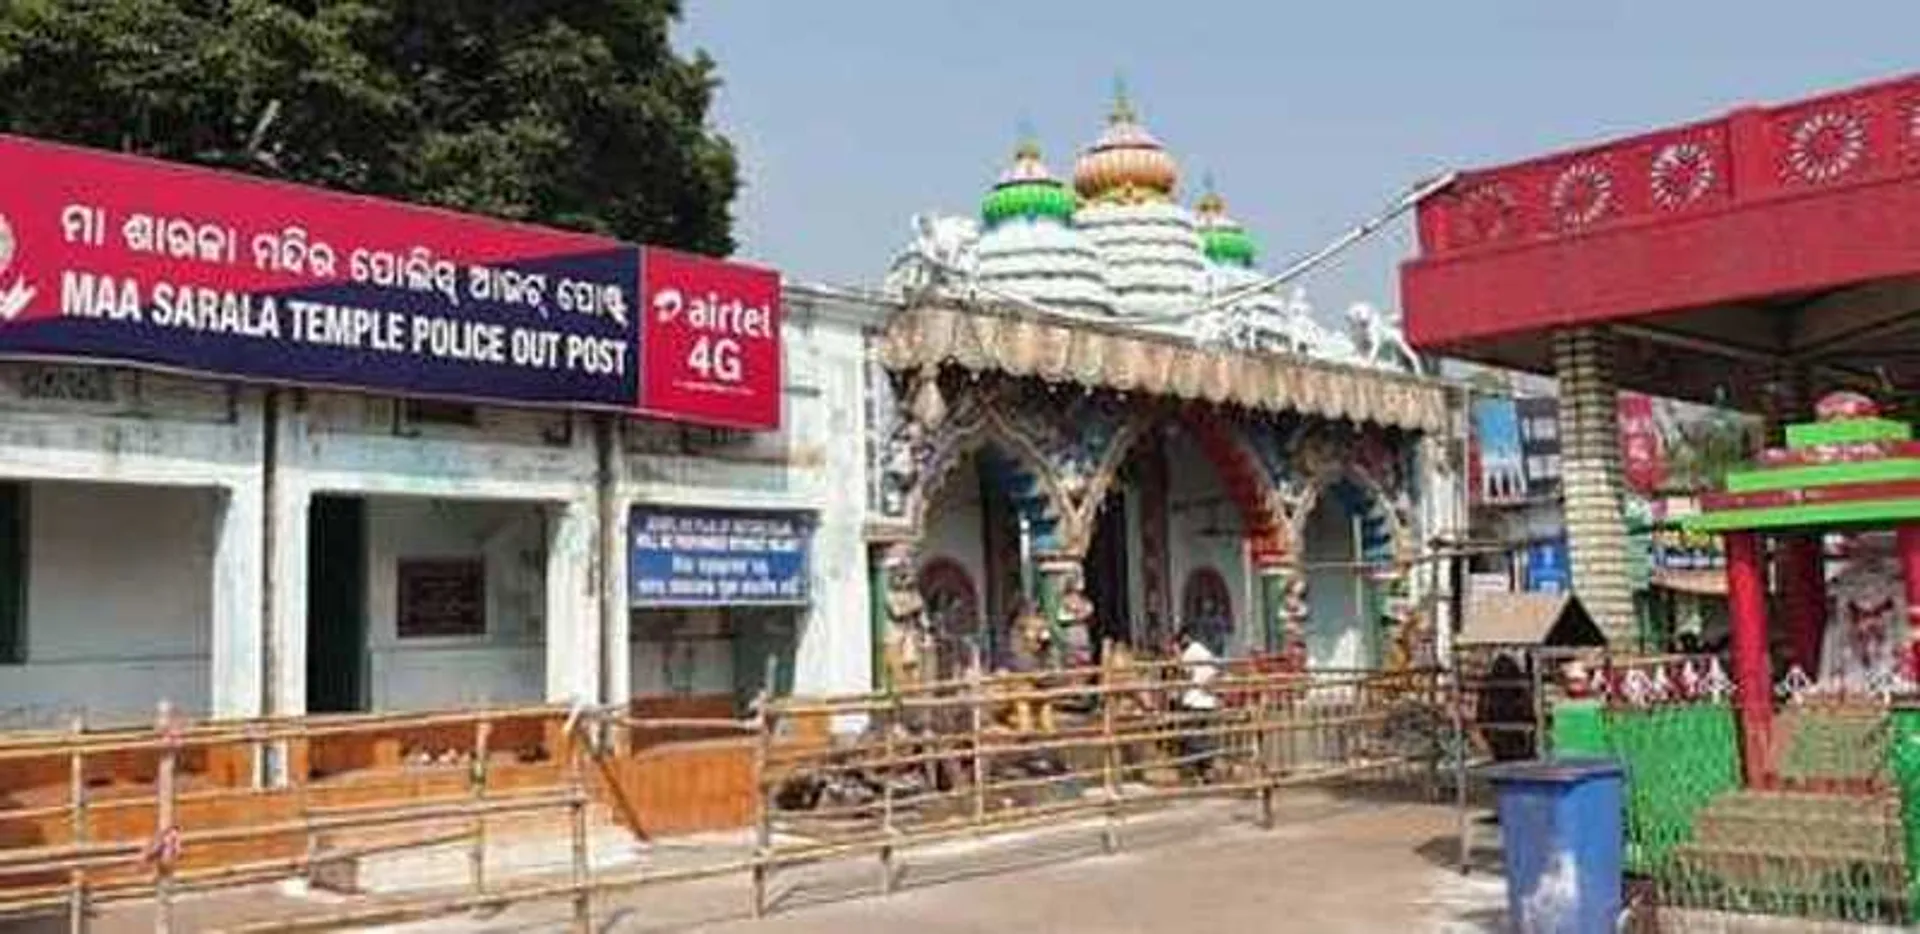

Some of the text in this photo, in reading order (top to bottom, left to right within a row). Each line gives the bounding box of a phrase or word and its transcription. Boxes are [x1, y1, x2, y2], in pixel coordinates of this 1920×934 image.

[61, 203, 106, 246] ମା
[122, 213, 237, 264] ଶାରଳା
[252, 226, 337, 278] ମନ୍ଦିର
[61, 270, 627, 376] MAA SARALA TEMPLE POLICE OUT POST
[688, 291, 771, 339] airtel
[688, 335, 742, 381] 4G
